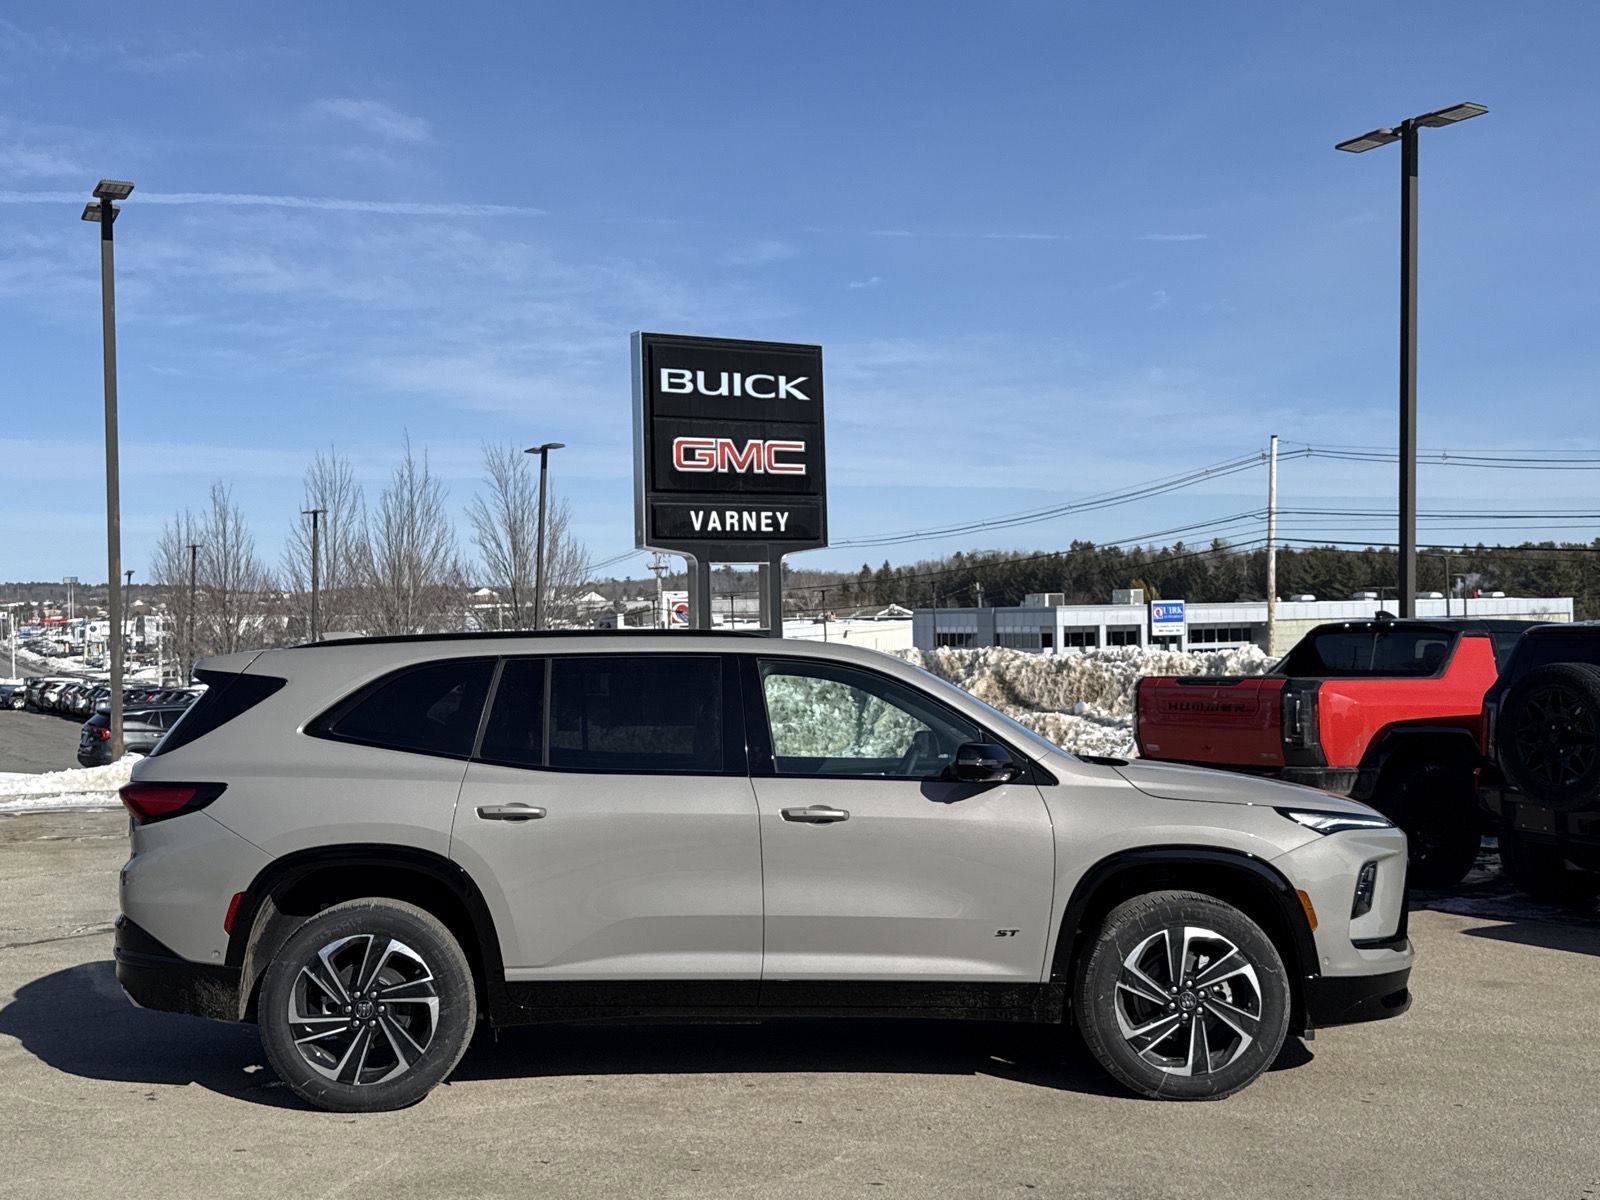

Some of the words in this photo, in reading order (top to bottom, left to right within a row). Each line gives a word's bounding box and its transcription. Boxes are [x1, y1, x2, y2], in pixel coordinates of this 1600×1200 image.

[660, 367, 811, 401] BUICK
[672, 436, 807, 475] GMC
[689, 510, 790, 533] VARNEY
[994, 929, 1020, 938] ST
